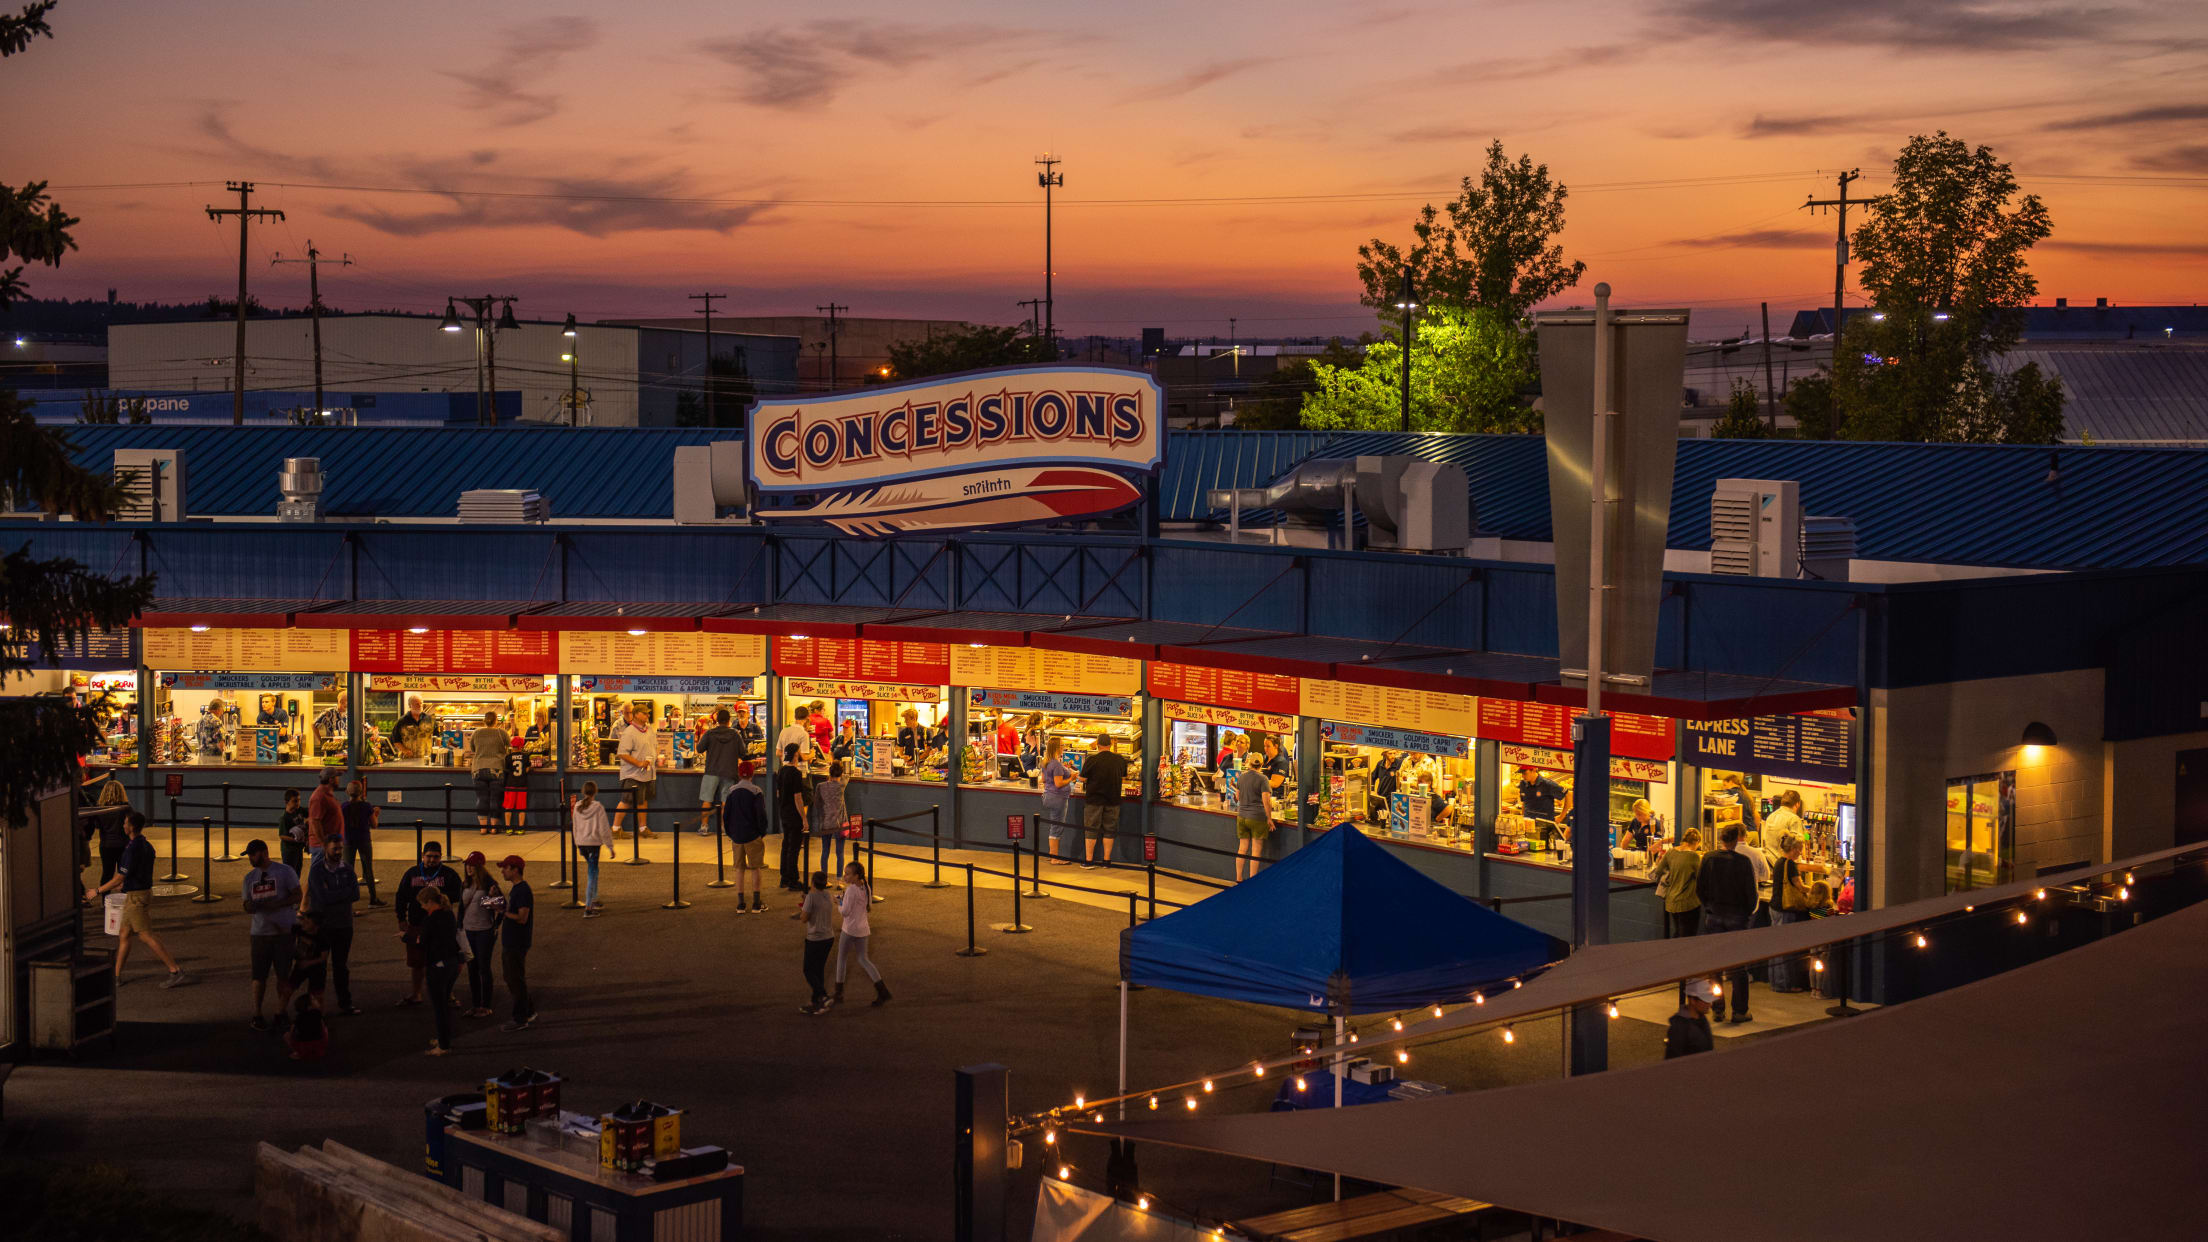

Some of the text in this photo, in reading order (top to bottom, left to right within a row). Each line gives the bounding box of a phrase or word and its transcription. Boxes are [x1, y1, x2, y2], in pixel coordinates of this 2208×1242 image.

[118, 398, 190, 412] prpane
[761, 387, 1148, 479] CONCESSIONS
[1368, 730, 1394, 739] SMUCKERS
[1686, 719, 1749, 736] EXPRESS
[1365, 737, 1398, 746] UNCRUSTABLE
[1404, 735, 1429, 743] GOLDFISH
[1433, 738, 1450, 746] CAPRI
[1698, 736, 1736, 756] LANE
[513, 760, 523, 776] 3
